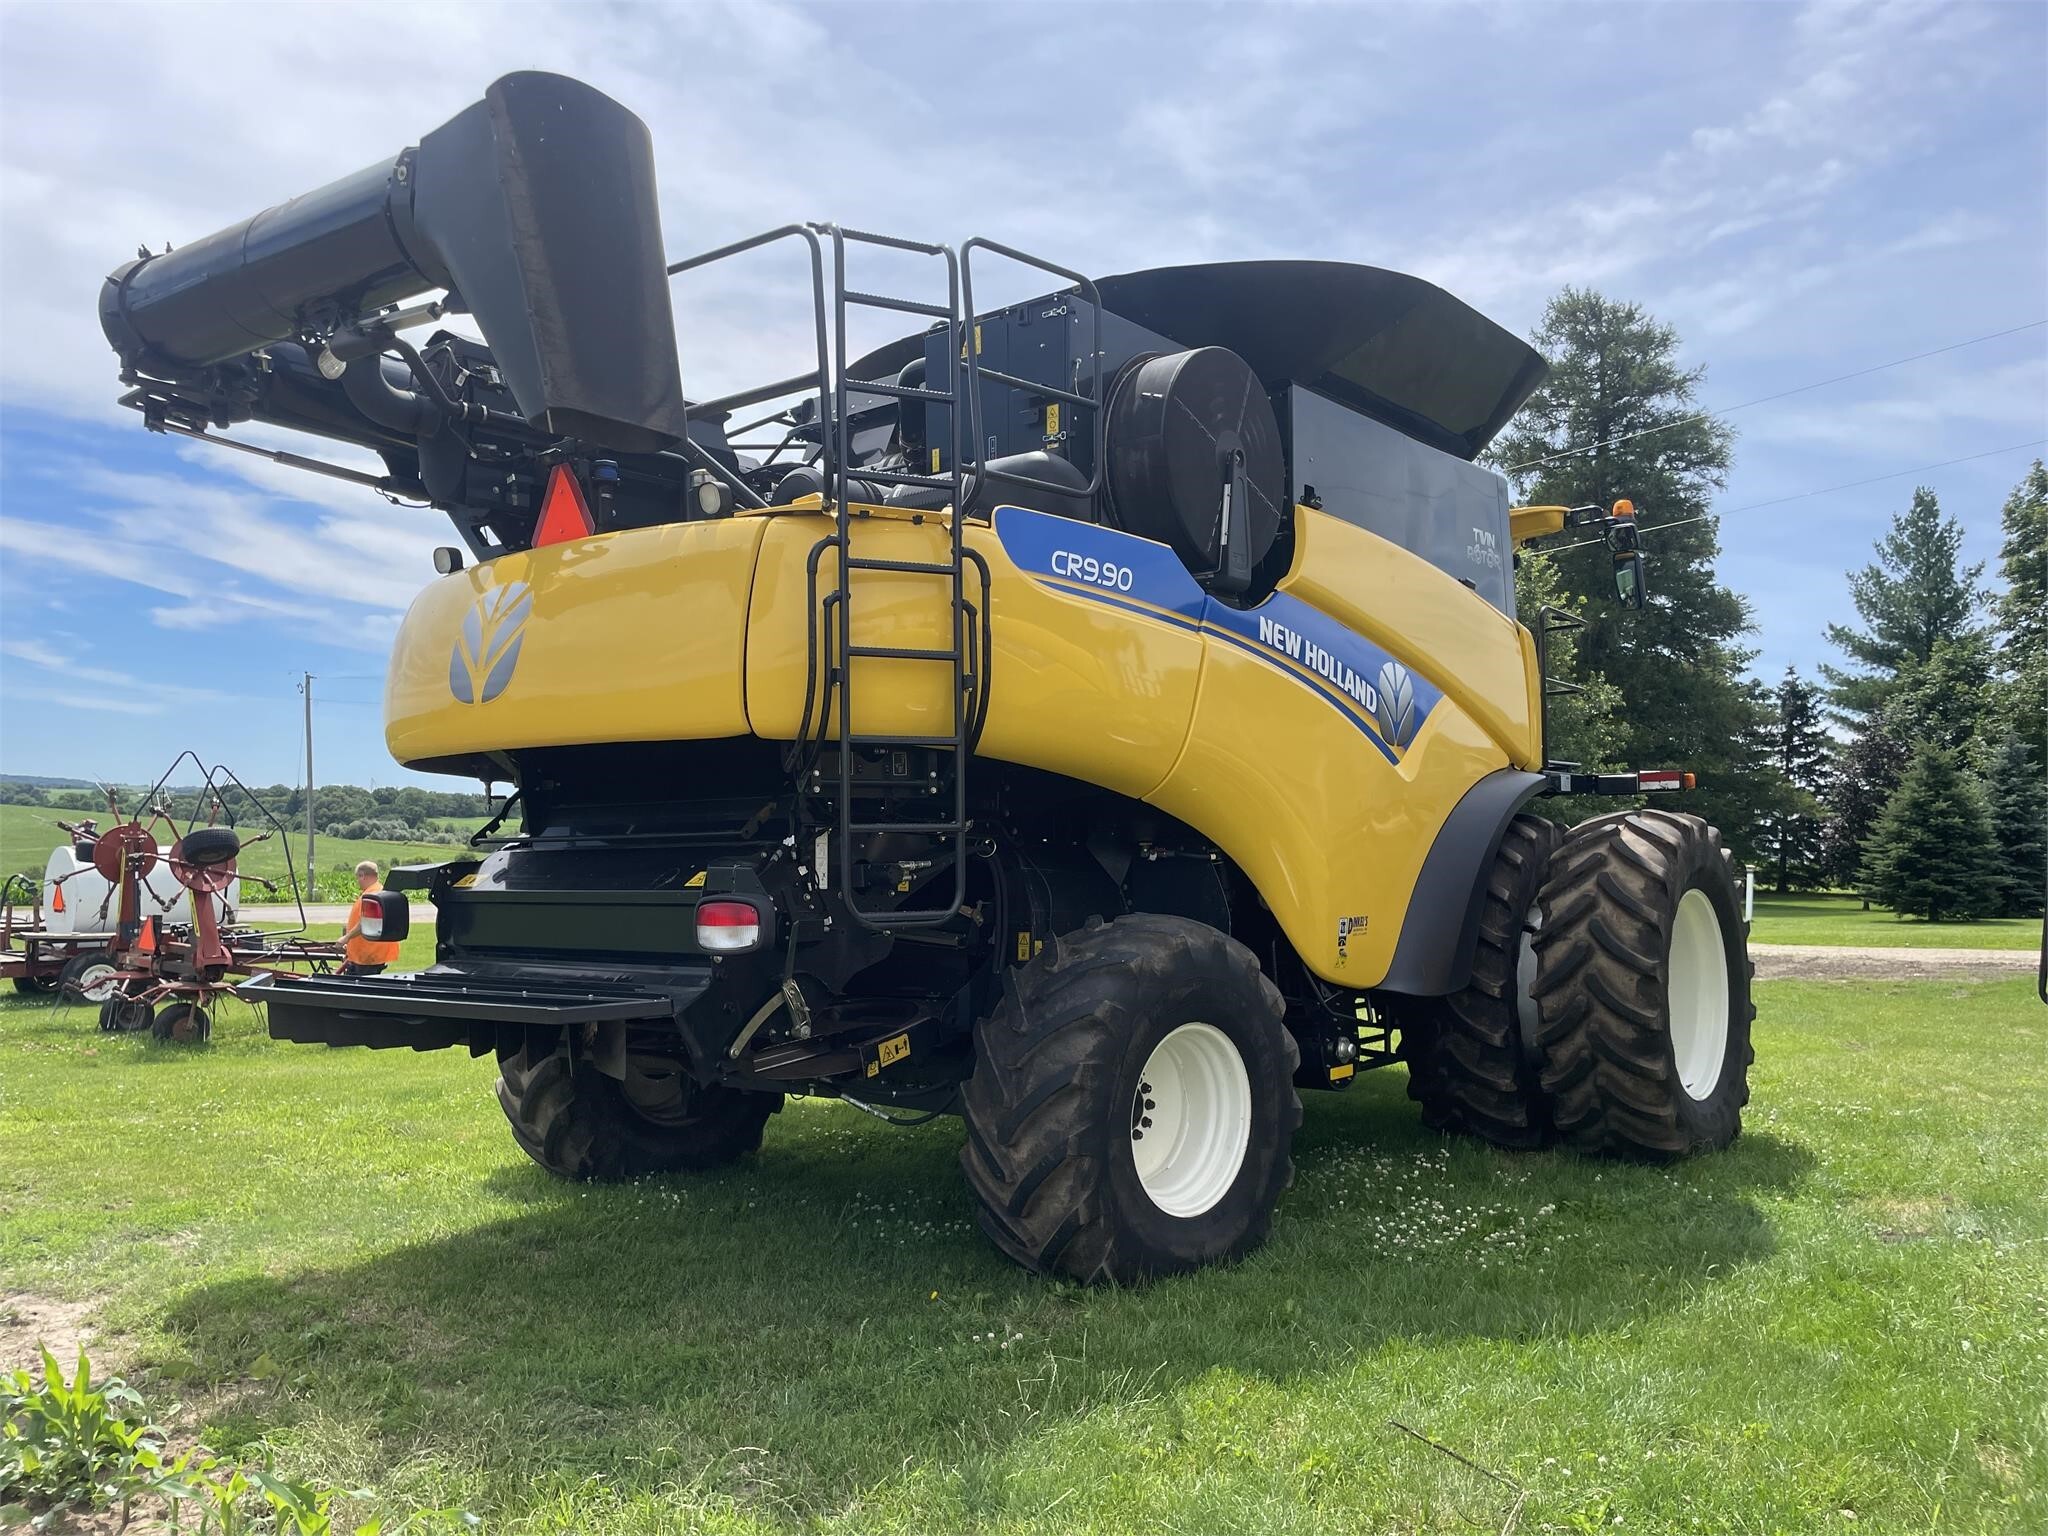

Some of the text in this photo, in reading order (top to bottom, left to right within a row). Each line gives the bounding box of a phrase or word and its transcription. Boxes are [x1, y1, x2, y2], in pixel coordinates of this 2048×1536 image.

[1051, 550, 1133, 592] CR9.90
[1259, 615, 1378, 715] NEW HOLLAND
